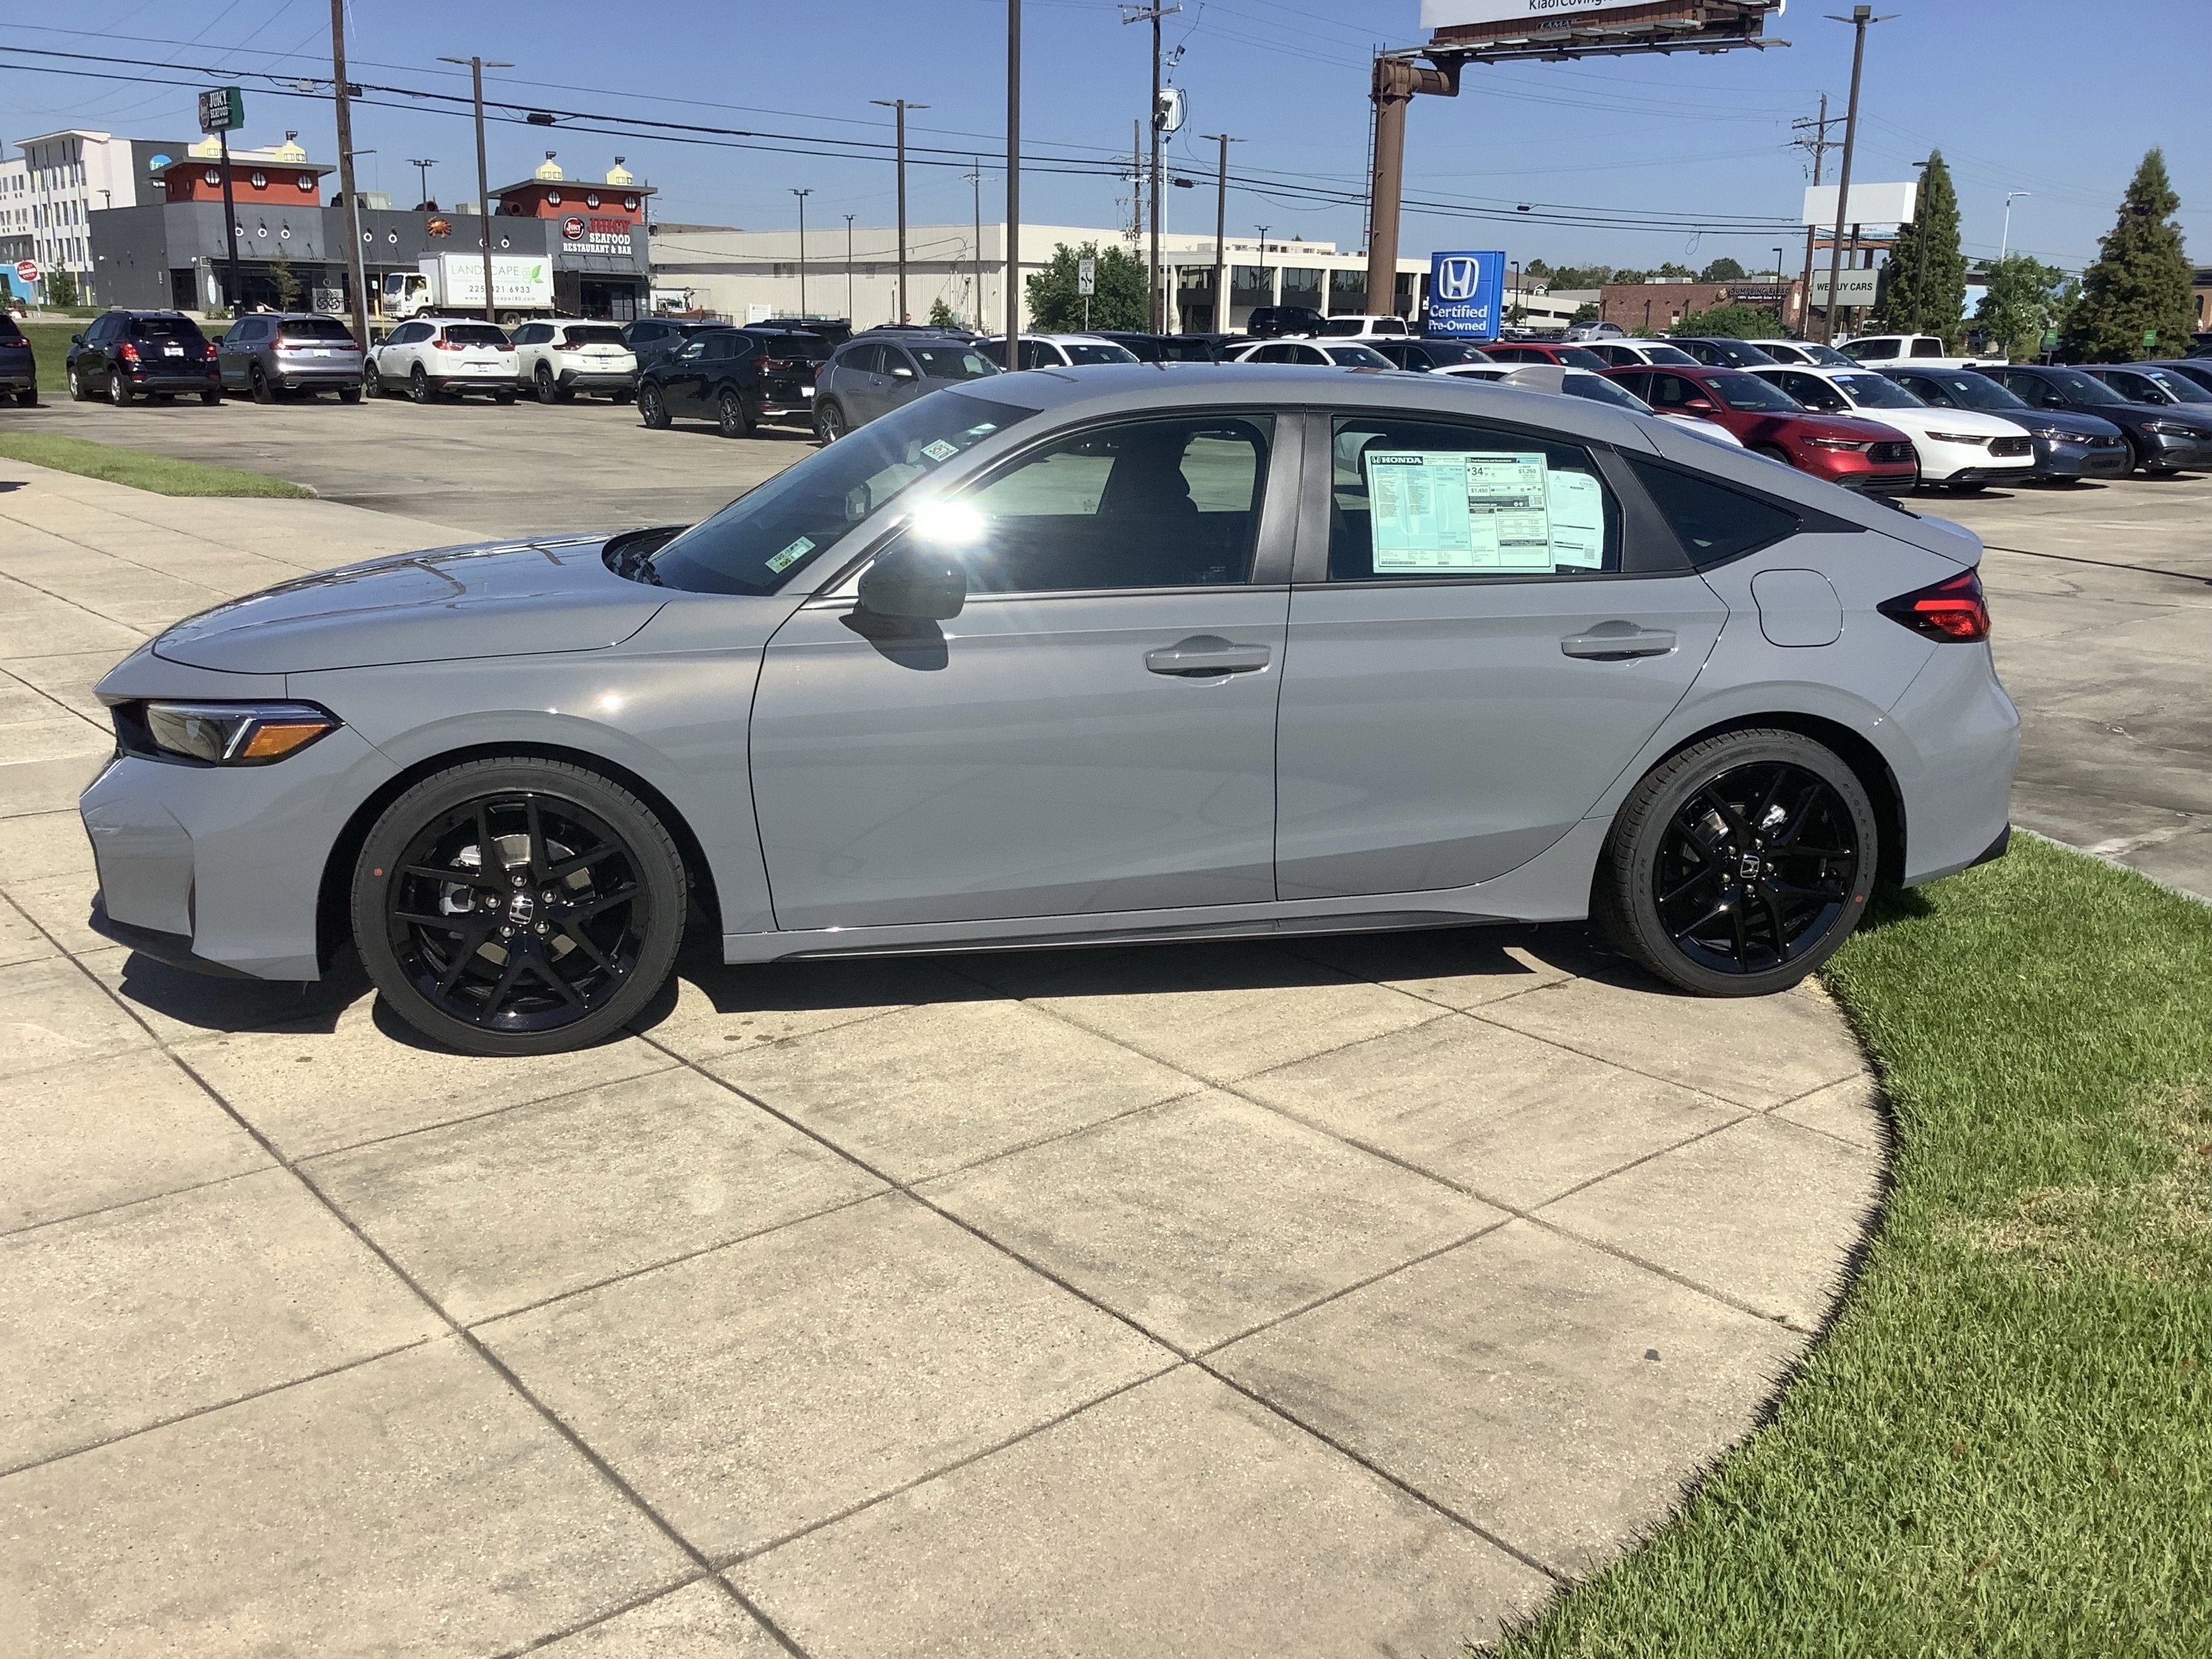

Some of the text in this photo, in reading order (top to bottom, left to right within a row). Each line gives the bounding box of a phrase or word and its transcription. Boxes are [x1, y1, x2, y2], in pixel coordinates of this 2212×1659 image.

[209, 90, 227, 108] JUICY
[210, 106, 228, 119] SEAFOOD
[587, 218, 630, 234] JUICY
[589, 233, 631, 245] SEAFOOD
[563, 243, 632, 255] RESTAURANT & BAR
[451, 265, 519, 276] LANDCAPE
[469, 285, 531, 293] 22521.6933
[1817, 283, 1873, 291] WE UY CARS
[1430, 305, 1488, 318] Certified
[1429, 319, 1487, 331] Pre-Owned
[1471, 467, 1483, 476] 34
